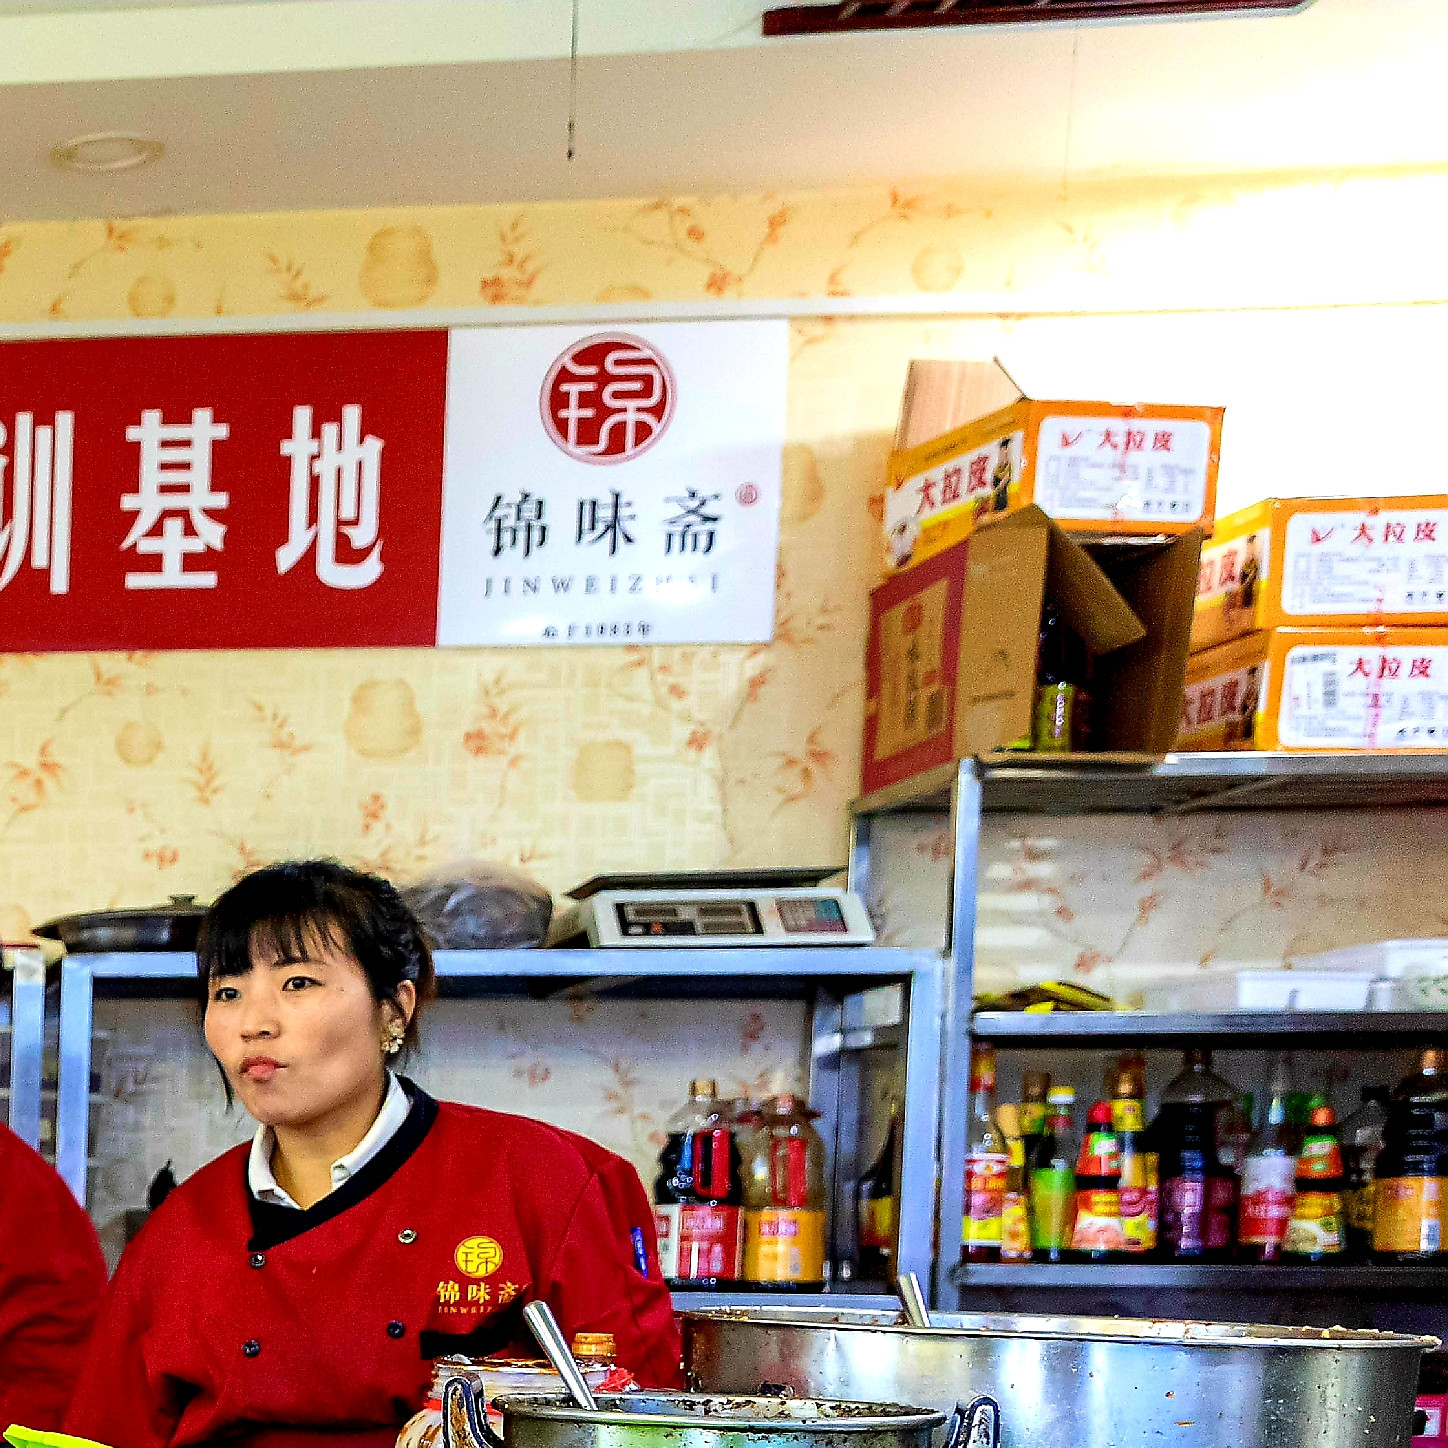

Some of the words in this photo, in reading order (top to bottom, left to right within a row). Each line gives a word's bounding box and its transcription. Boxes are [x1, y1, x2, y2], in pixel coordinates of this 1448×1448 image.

[1099, 429, 1173, 453] 大拉皮
[484, 490, 720, 558] 锦味斋
[1351, 522, 1437, 544] 大拉皮
[1347, 655, 1433, 680] 大拉皮
